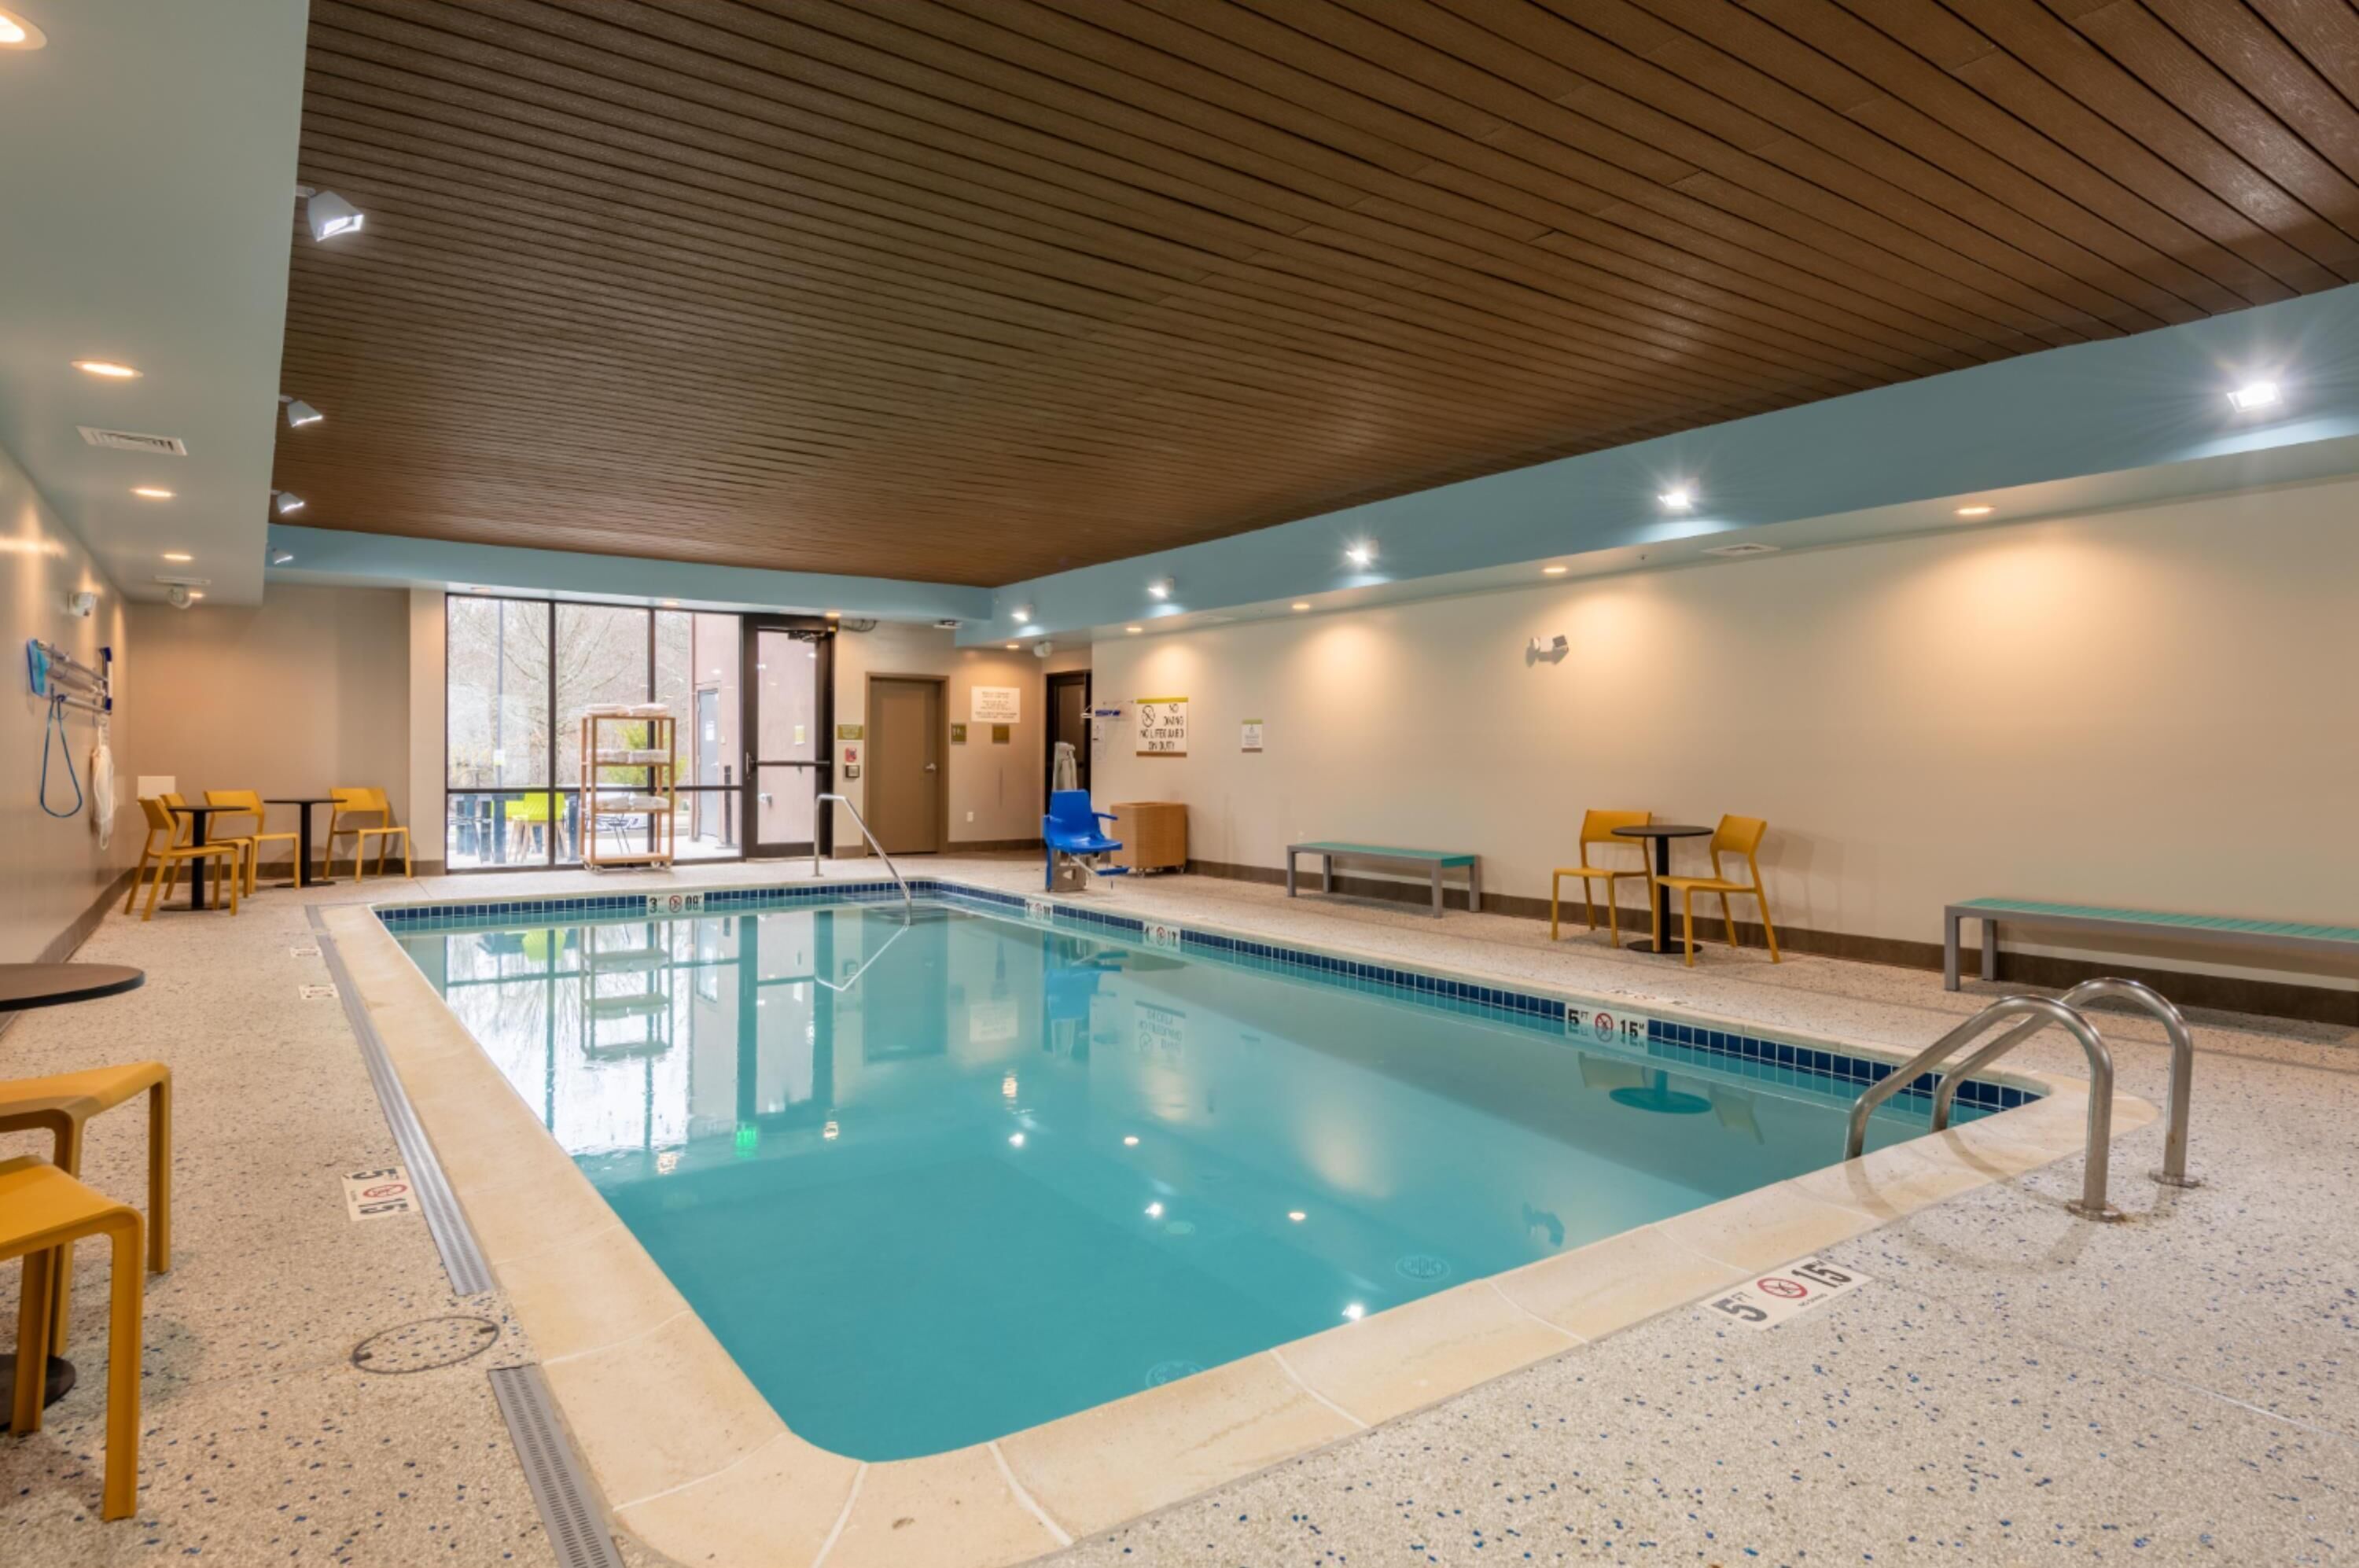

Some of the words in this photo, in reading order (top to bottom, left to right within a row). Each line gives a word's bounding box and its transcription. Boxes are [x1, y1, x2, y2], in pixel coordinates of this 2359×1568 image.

[1567, 1008, 1580, 1025] 5
[1581, 1011, 1590, 1020] FT
[1710, 1297, 1768, 1322] 5
